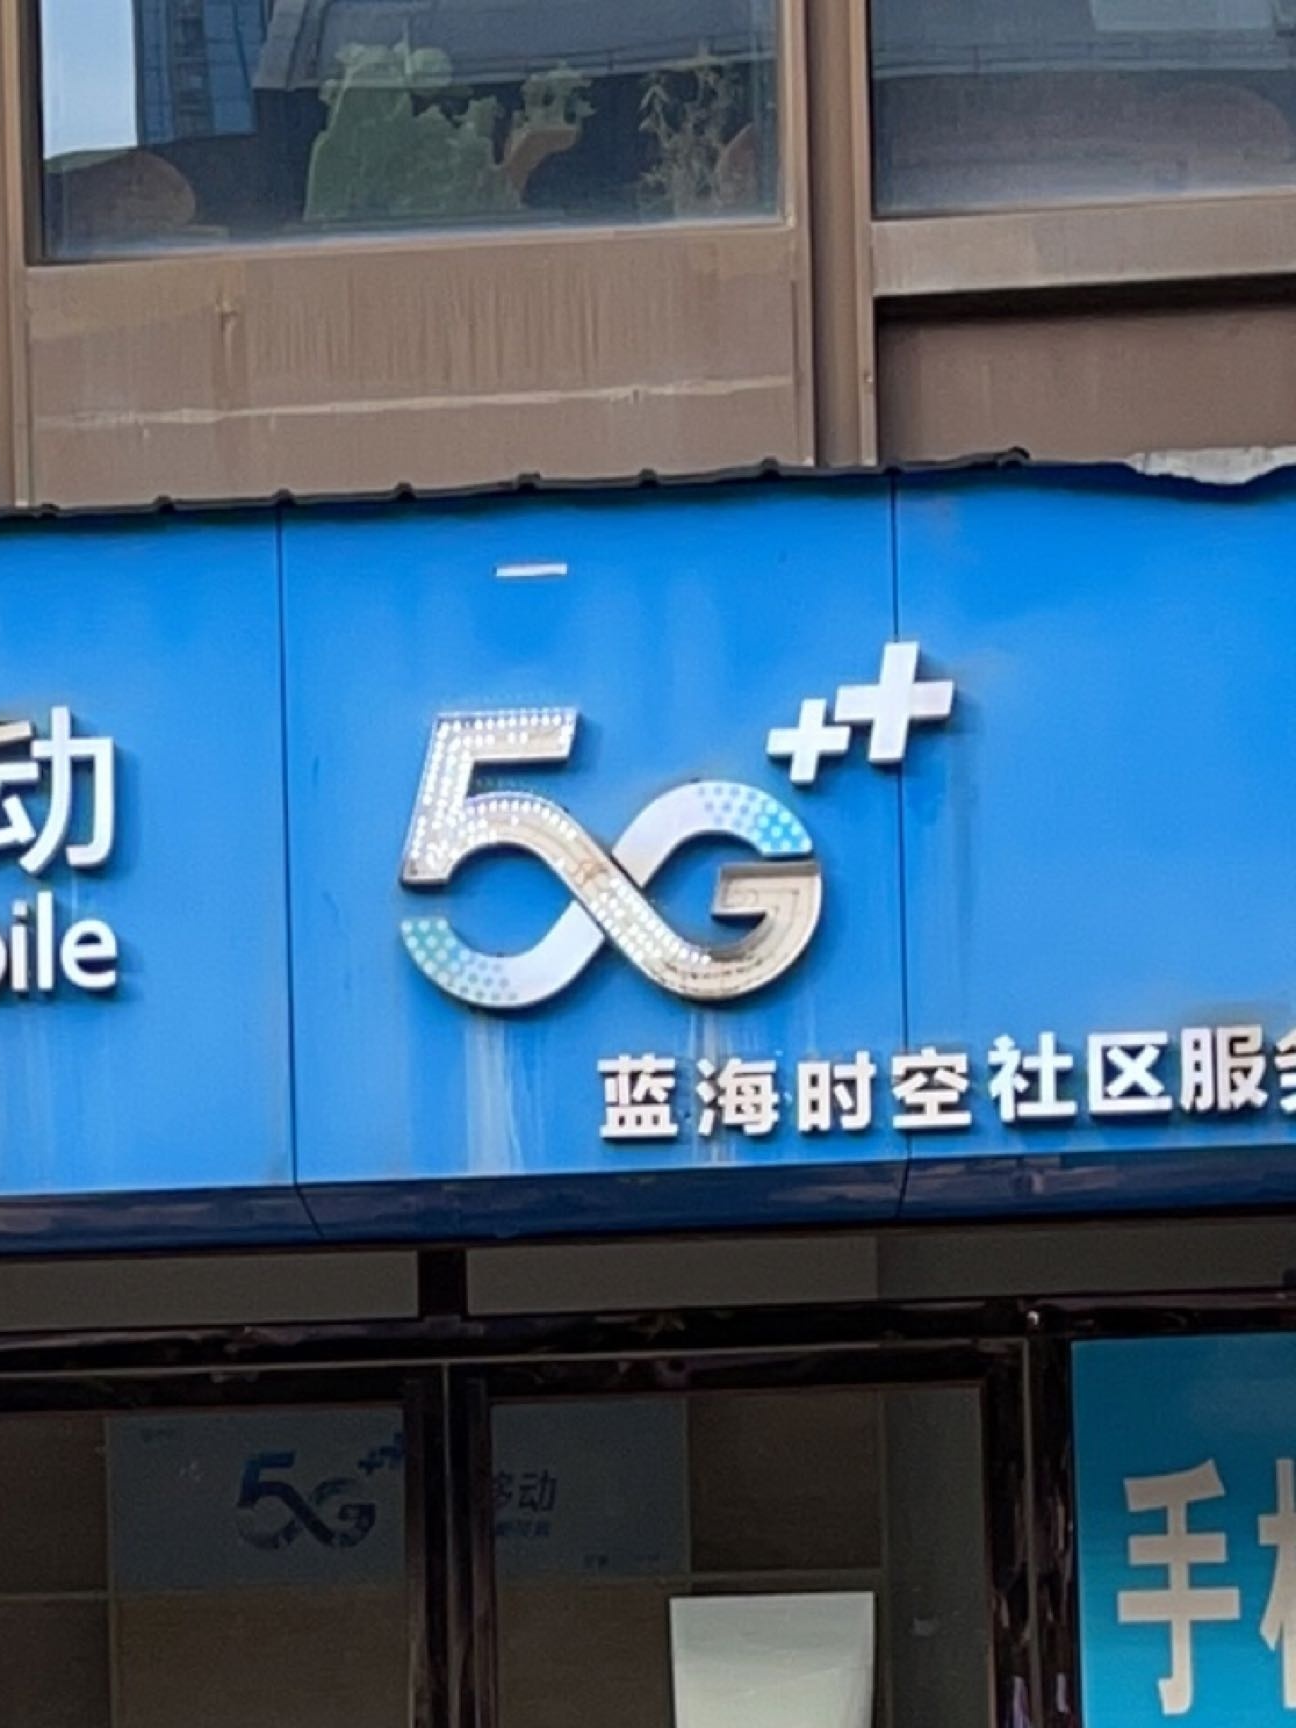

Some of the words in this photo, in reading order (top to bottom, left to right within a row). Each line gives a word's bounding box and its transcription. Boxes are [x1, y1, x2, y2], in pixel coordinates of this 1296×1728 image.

[597, 1024, 1296, 1141] 蓝海时空社区服
